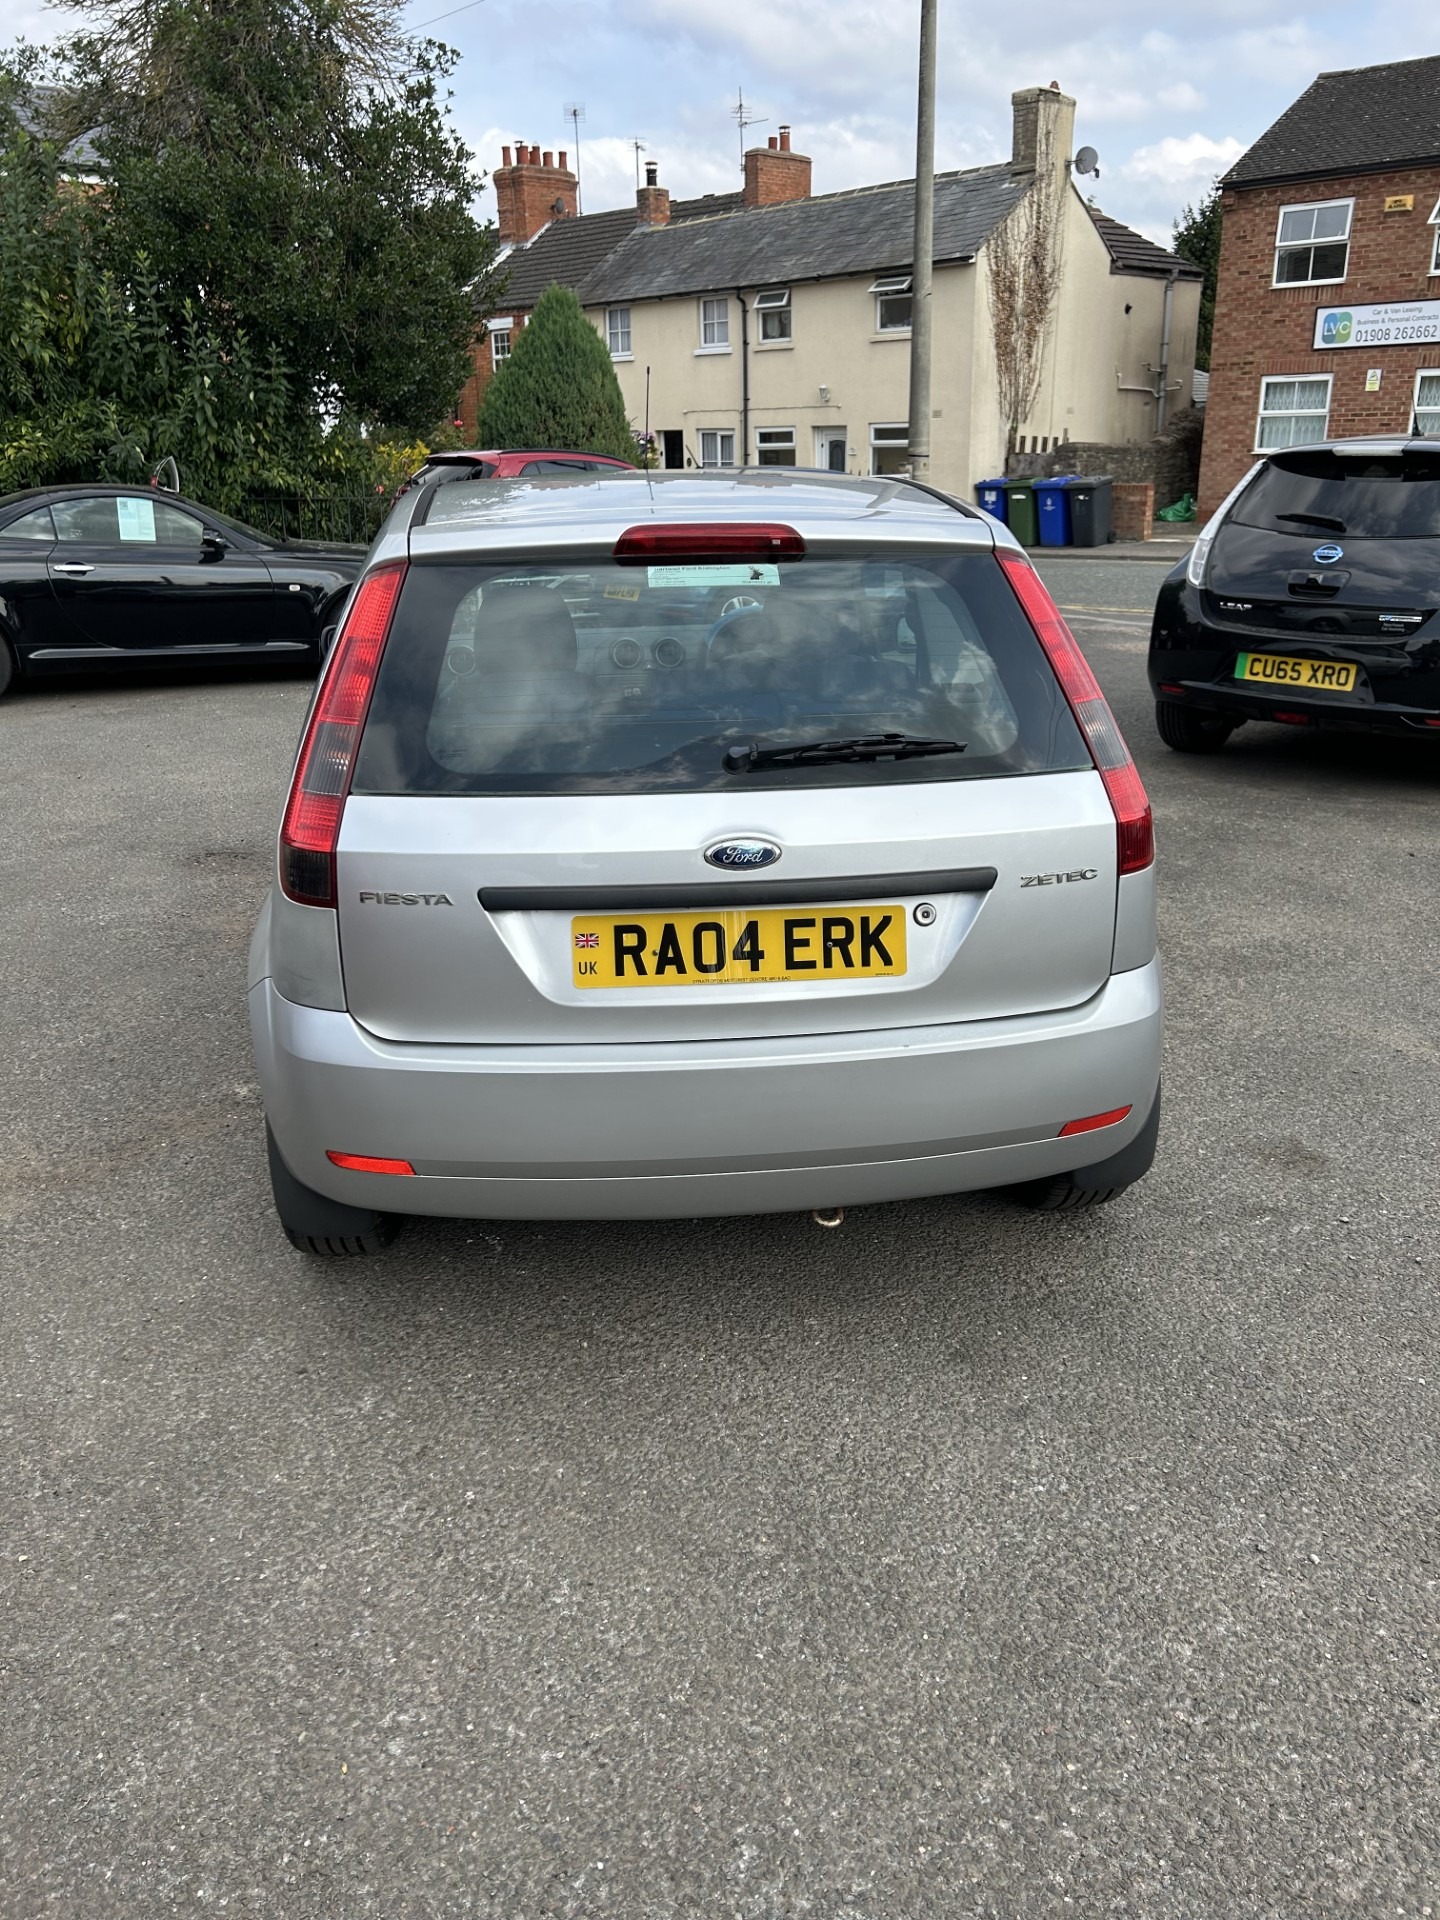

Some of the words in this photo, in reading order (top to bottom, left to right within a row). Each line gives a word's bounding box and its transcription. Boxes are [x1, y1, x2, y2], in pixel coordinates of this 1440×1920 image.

[1324, 320, 1351, 335] LVC
[1387, 315, 1411, 323] Personal
[1355, 327, 1391, 342] 01908
[1394, 324, 1438, 340] 262662
[1248, 657, 1303, 682] CU65
[1307, 662, 1350, 687] XRO
[722, 845, 764, 866] Ford
[1020, 867, 1098, 889] ZETEC
[359, 891, 455, 907] FIESTA
[613, 920, 765, 977] RA04
[784, 914, 894, 971] ERK
[578, 961, 598, 975] UK
